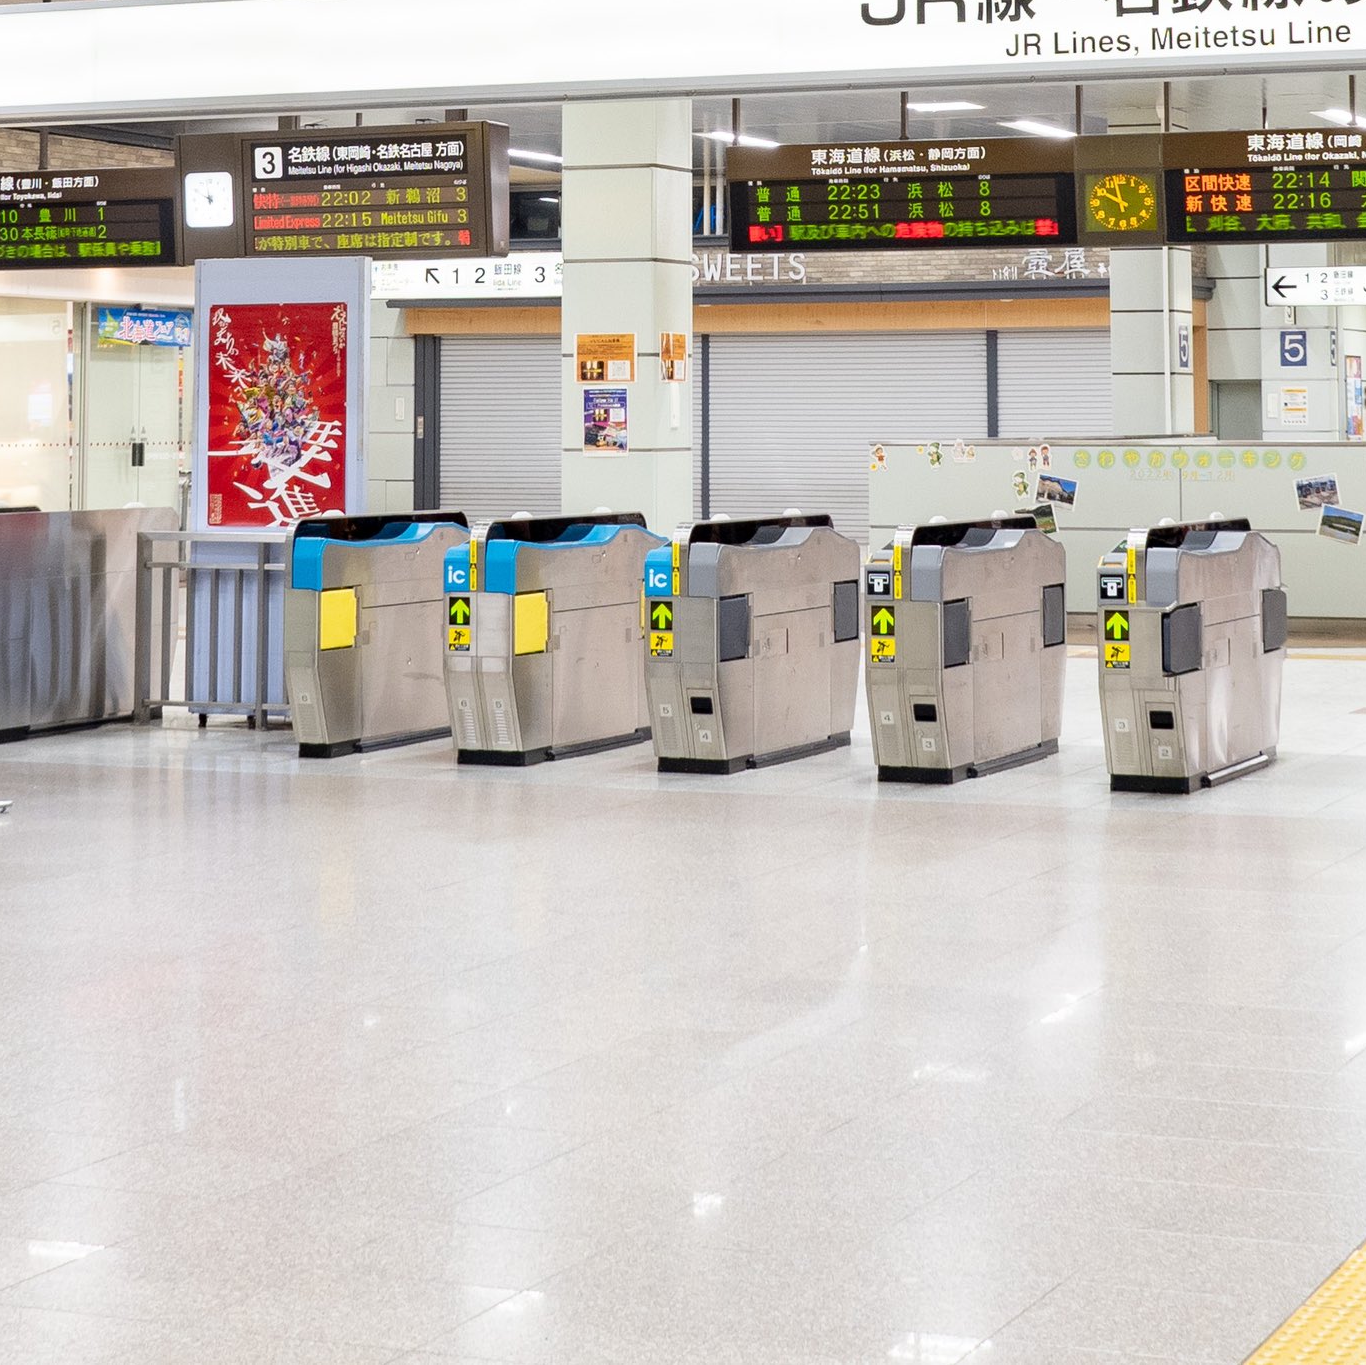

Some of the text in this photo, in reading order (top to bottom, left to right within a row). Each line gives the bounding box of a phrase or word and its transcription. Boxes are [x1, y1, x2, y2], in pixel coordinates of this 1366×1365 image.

[1006, 20, 1351, 57] JR Lines, Meitetsu Line
[262, 153, 276, 175] 3
[1283, 153, 1303, 162] Line
[1322, 151, 1359, 162] Okazaki,
[288, 159, 463, 176] Meitetsu Line (for Higashi Okazaki, Meitetsu Nagoya)
[844, 166, 862, 174] Line
[879, 164, 928, 174] Hamamatsu,
[1185, 174, 1252, 191] 区間快速
[1272, 172, 1330, 189] 22:14
[321, 190, 371, 206] 22:02
[456, 186, 467, 202] 3
[756, 181, 990, 203] 普通 22:23 浜松 8
[1143, 197, 1152, 206] 3
[757, 200, 991, 222] 普通 22:51 浜松 8
[1186, 193, 1253, 212] 新快速
[1273, 192, 1332, 209] 22:16
[39, 207, 76, 223] 豊川
[97, 207, 105, 221] 1
[254, 208, 467, 230] Limited Express 22:15 Meitetsu Gifu 3
[1108, 217, 1116, 226] 7
[1139, 209, 1147, 218] 4
[97, 224, 107, 239] 2
[452, 267, 460, 285] 1
[474, 267, 486, 284] 2
[534, 266, 546, 283] 3
[1304, 273, 1310, 283] 1
[1320, 272, 1328, 284] 2
[1320, 289, 1329, 301] 3
[1283, 334, 1305, 363] 5
[1073, 449, 1307, 471] さわやかウォーキング
[447, 565, 466, 585] ic
[648, 568, 668, 589] ic
